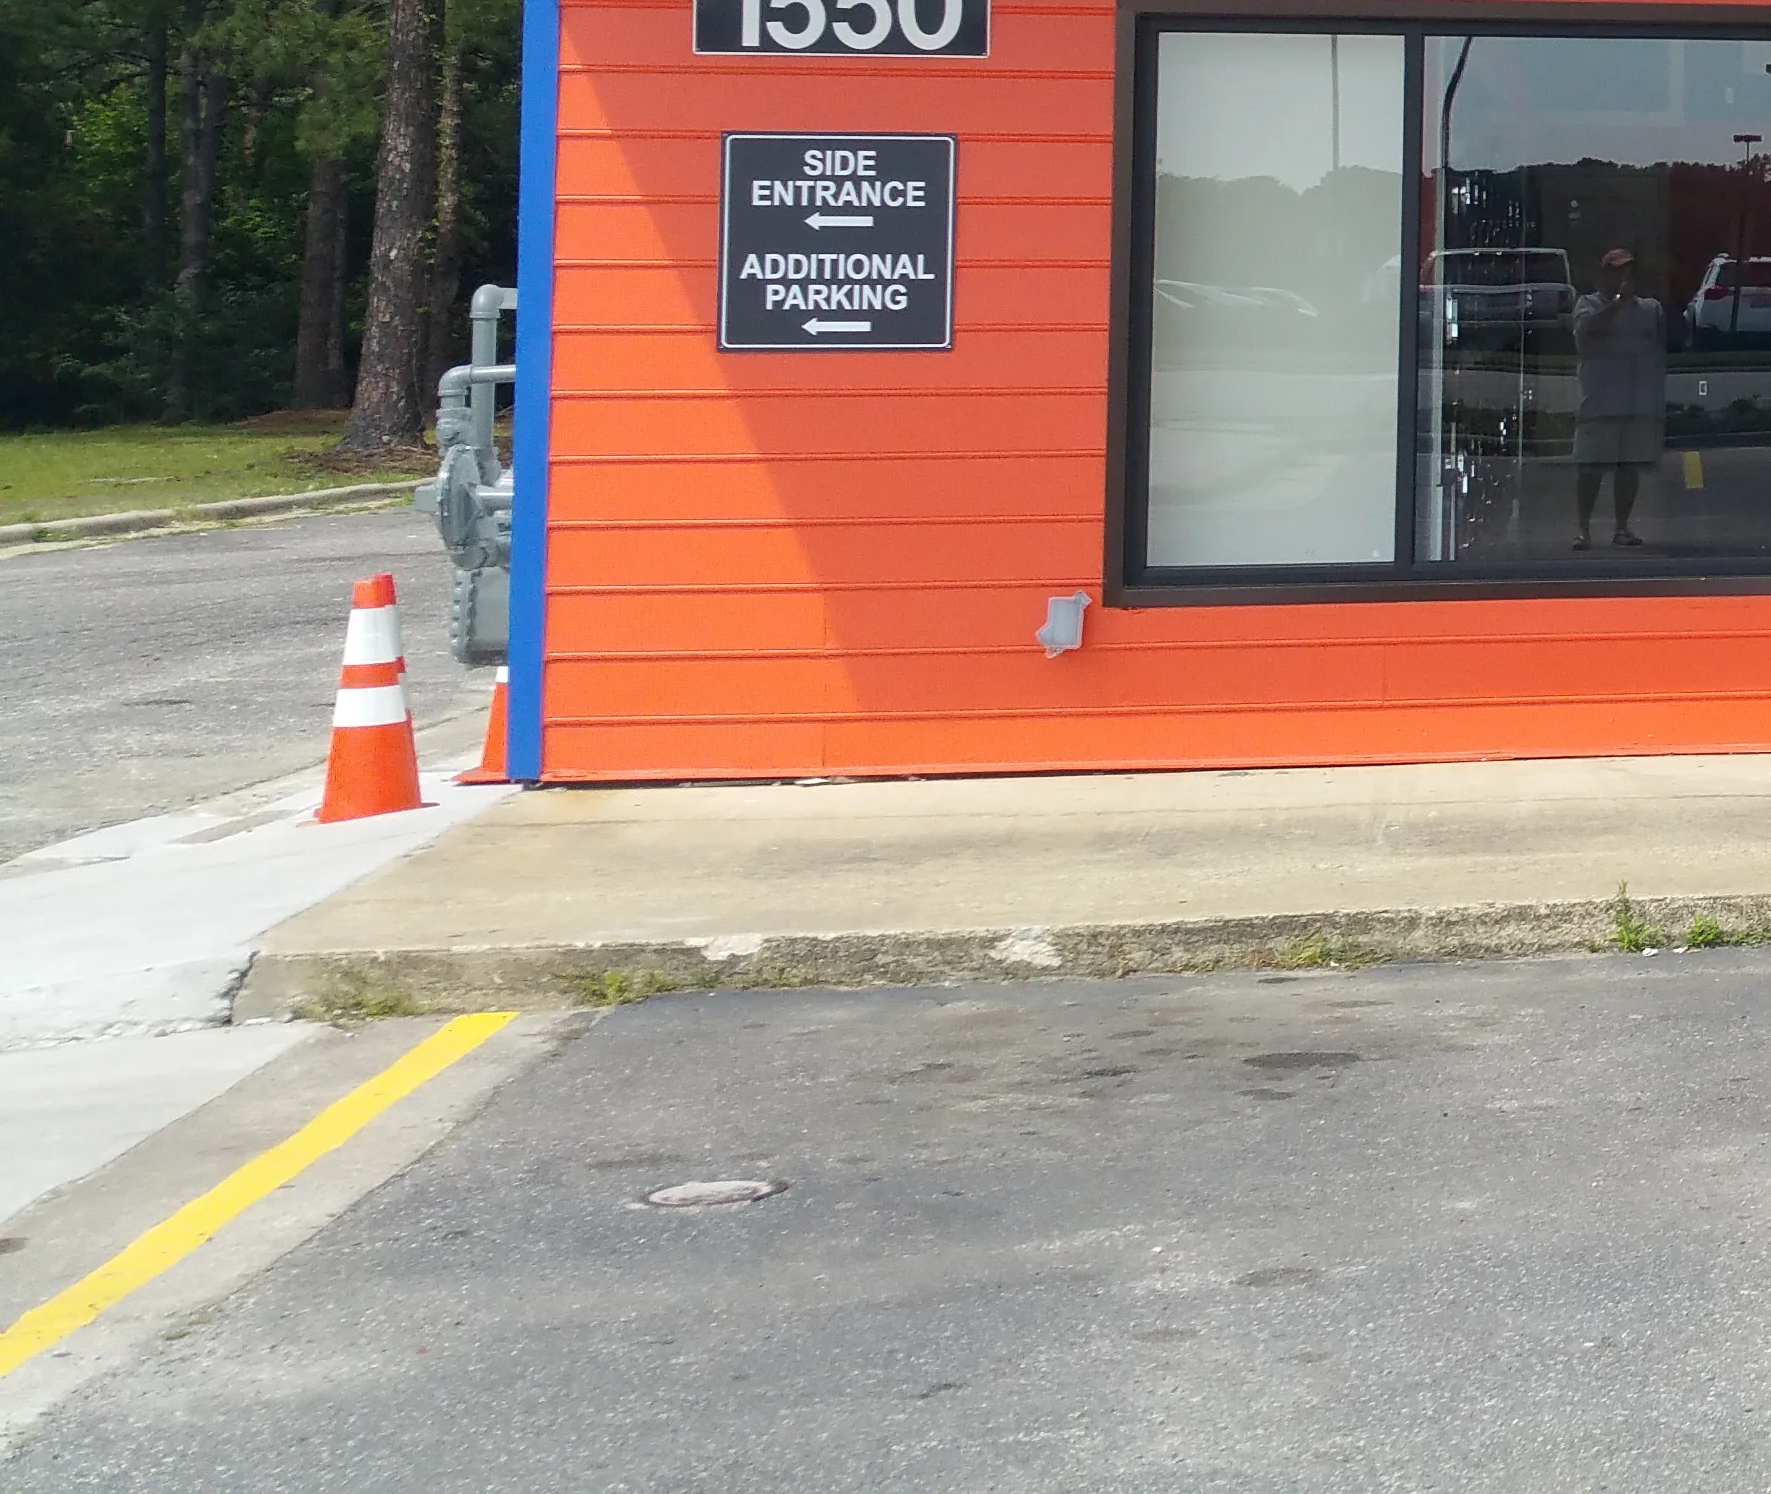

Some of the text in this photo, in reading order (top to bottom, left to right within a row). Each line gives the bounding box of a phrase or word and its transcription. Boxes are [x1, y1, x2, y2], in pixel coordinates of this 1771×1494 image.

[803, 150, 877, 177] SIDE
[751, 180, 926, 207] ENTRANCE
[740, 253, 935, 280] ADDITIONAL
[765, 284, 909, 311] PARKING
